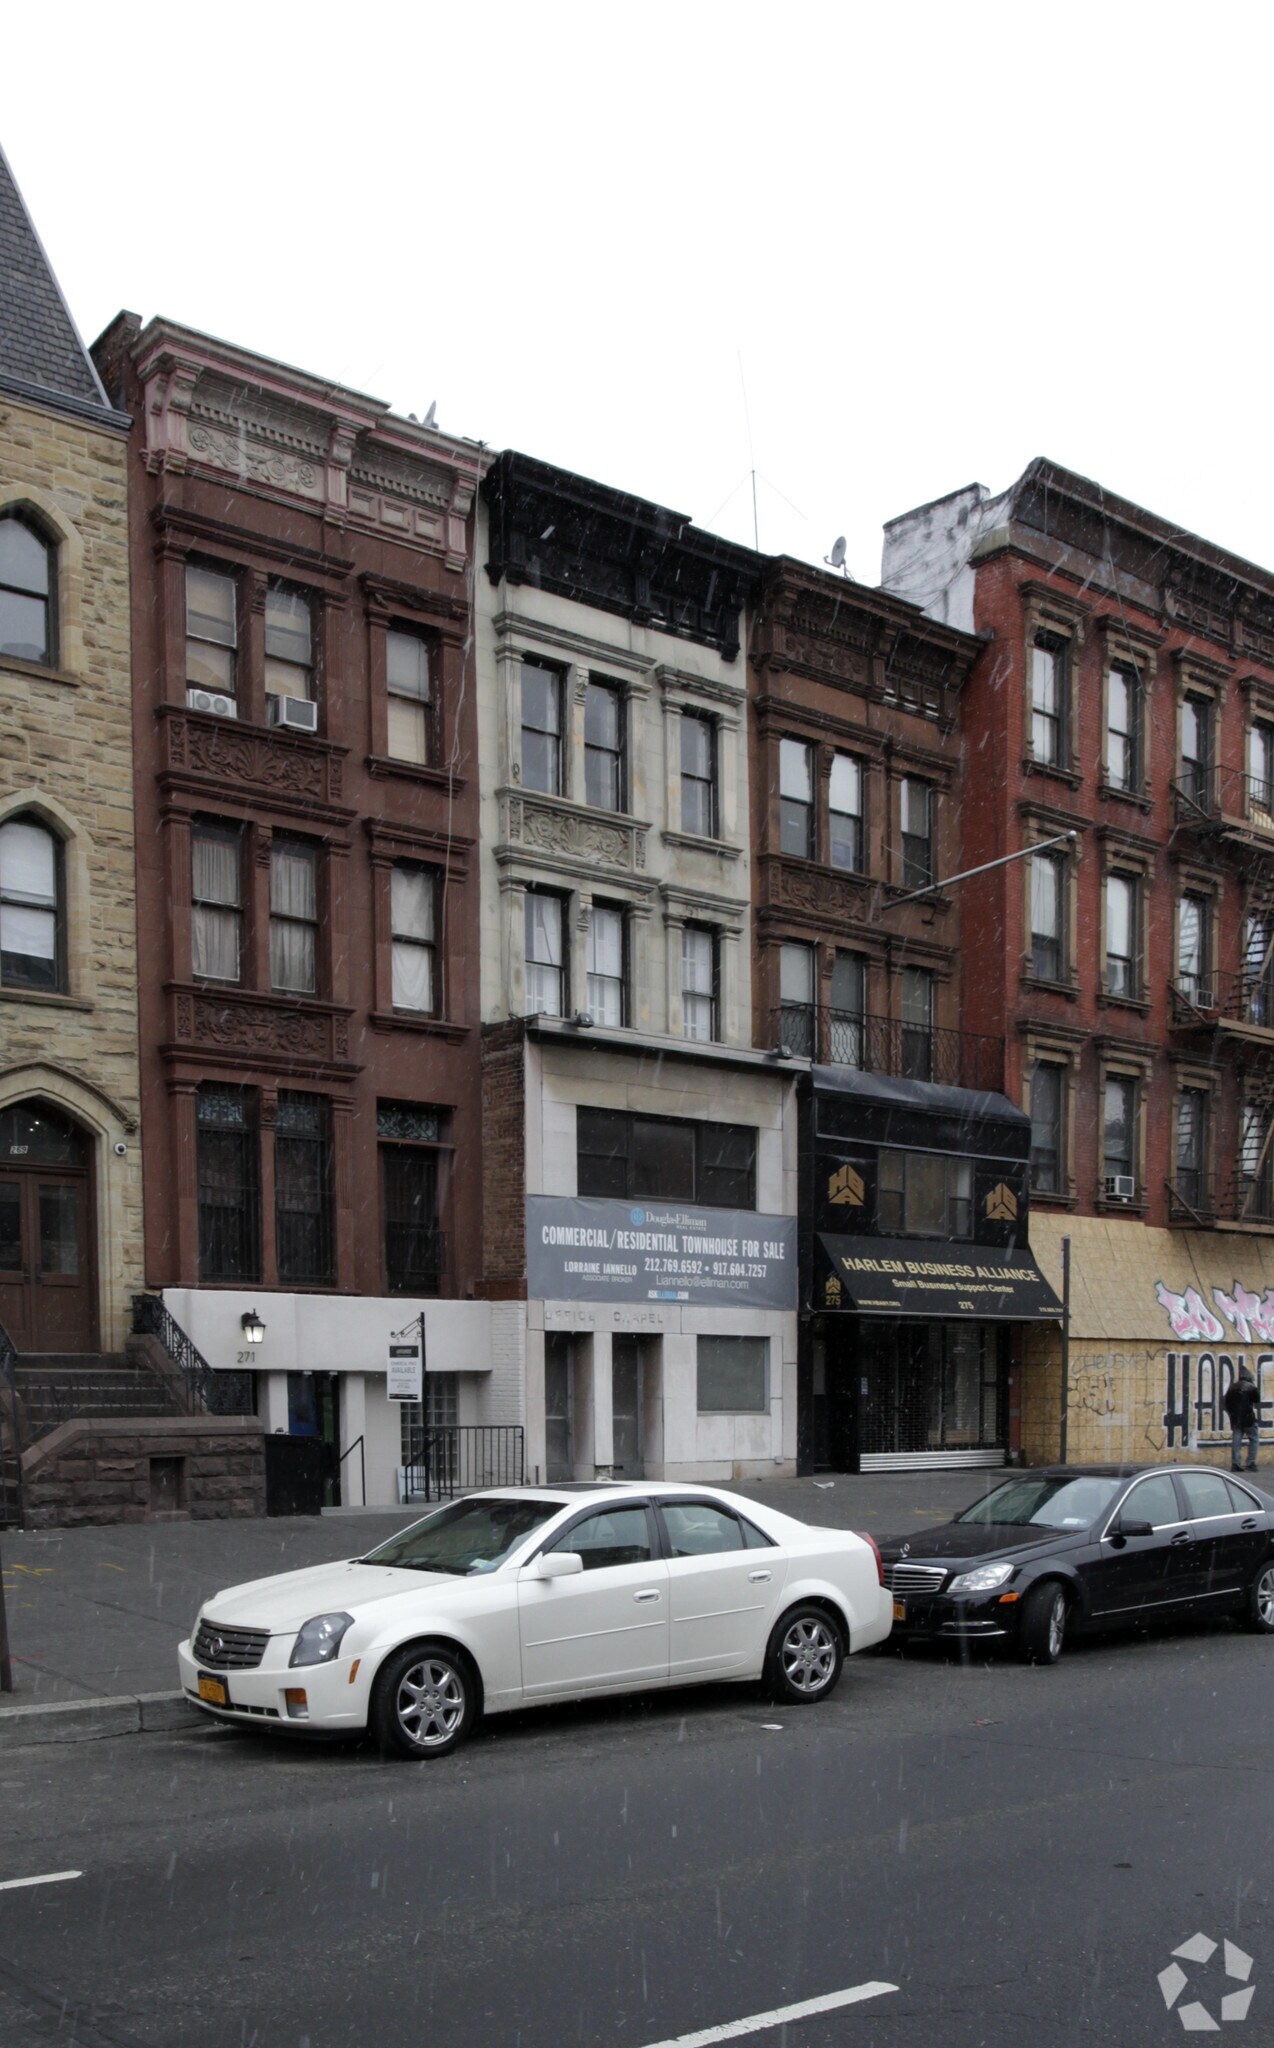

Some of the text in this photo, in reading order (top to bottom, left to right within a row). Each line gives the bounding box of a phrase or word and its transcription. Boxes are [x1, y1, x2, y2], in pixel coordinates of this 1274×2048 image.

[682, 1235, 738, 1257] TOWNHOUSE
[742, 1240, 760, 1258] FOR
[763, 1241, 785, 1260] SALE
[564, 1261, 637, 1275] LORRAINE IANNELLO
[644, 1257, 767, 1278] 212.769.6592 917.604.7257
[841, 1257, 1040, 1281] HARLEM BUSINESS ALLIANCE
[891, 1279, 1014, 1293] Small Business Support Center
[825, 1295, 841, 1306] 275
[958, 1301, 975, 1310] 275
[236, 1351, 255, 1364] 271
